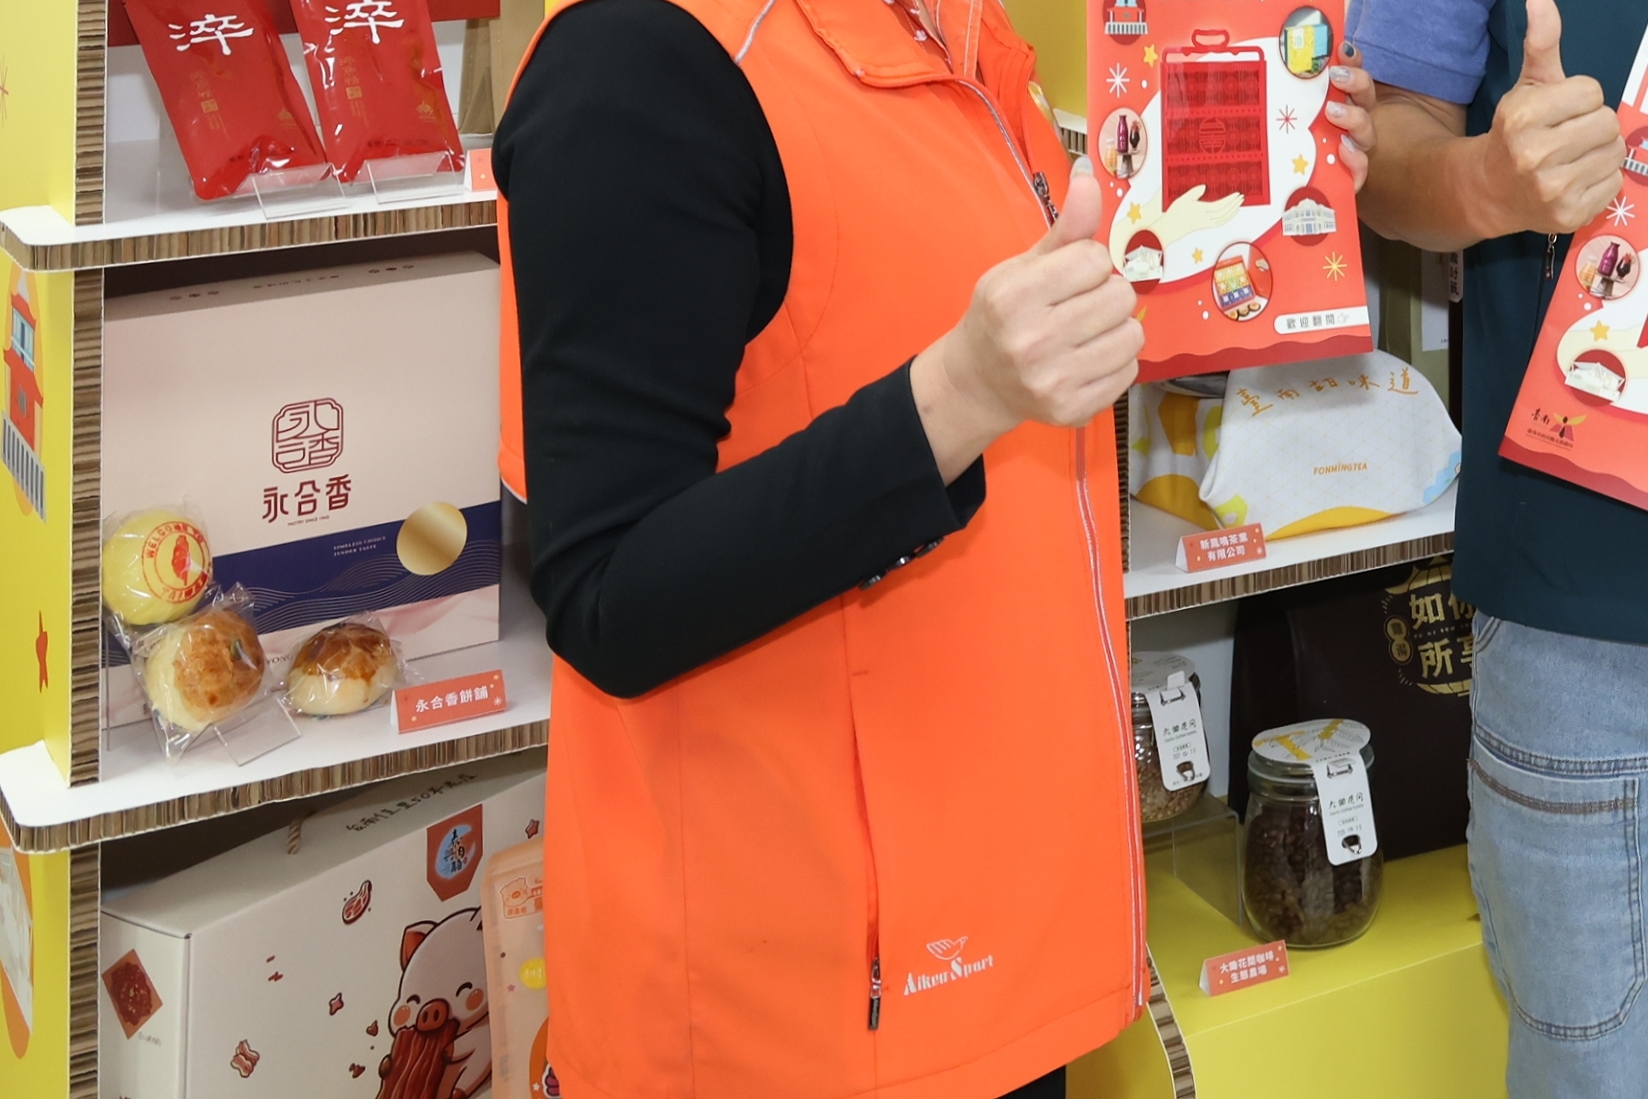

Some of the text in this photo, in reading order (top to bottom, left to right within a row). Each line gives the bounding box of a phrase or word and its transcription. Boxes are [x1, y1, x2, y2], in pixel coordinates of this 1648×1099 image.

[168, 14, 254, 56] 淬
[262, 474, 351, 523] 永合香
[1207, 545, 1245, 562] 有限公司
